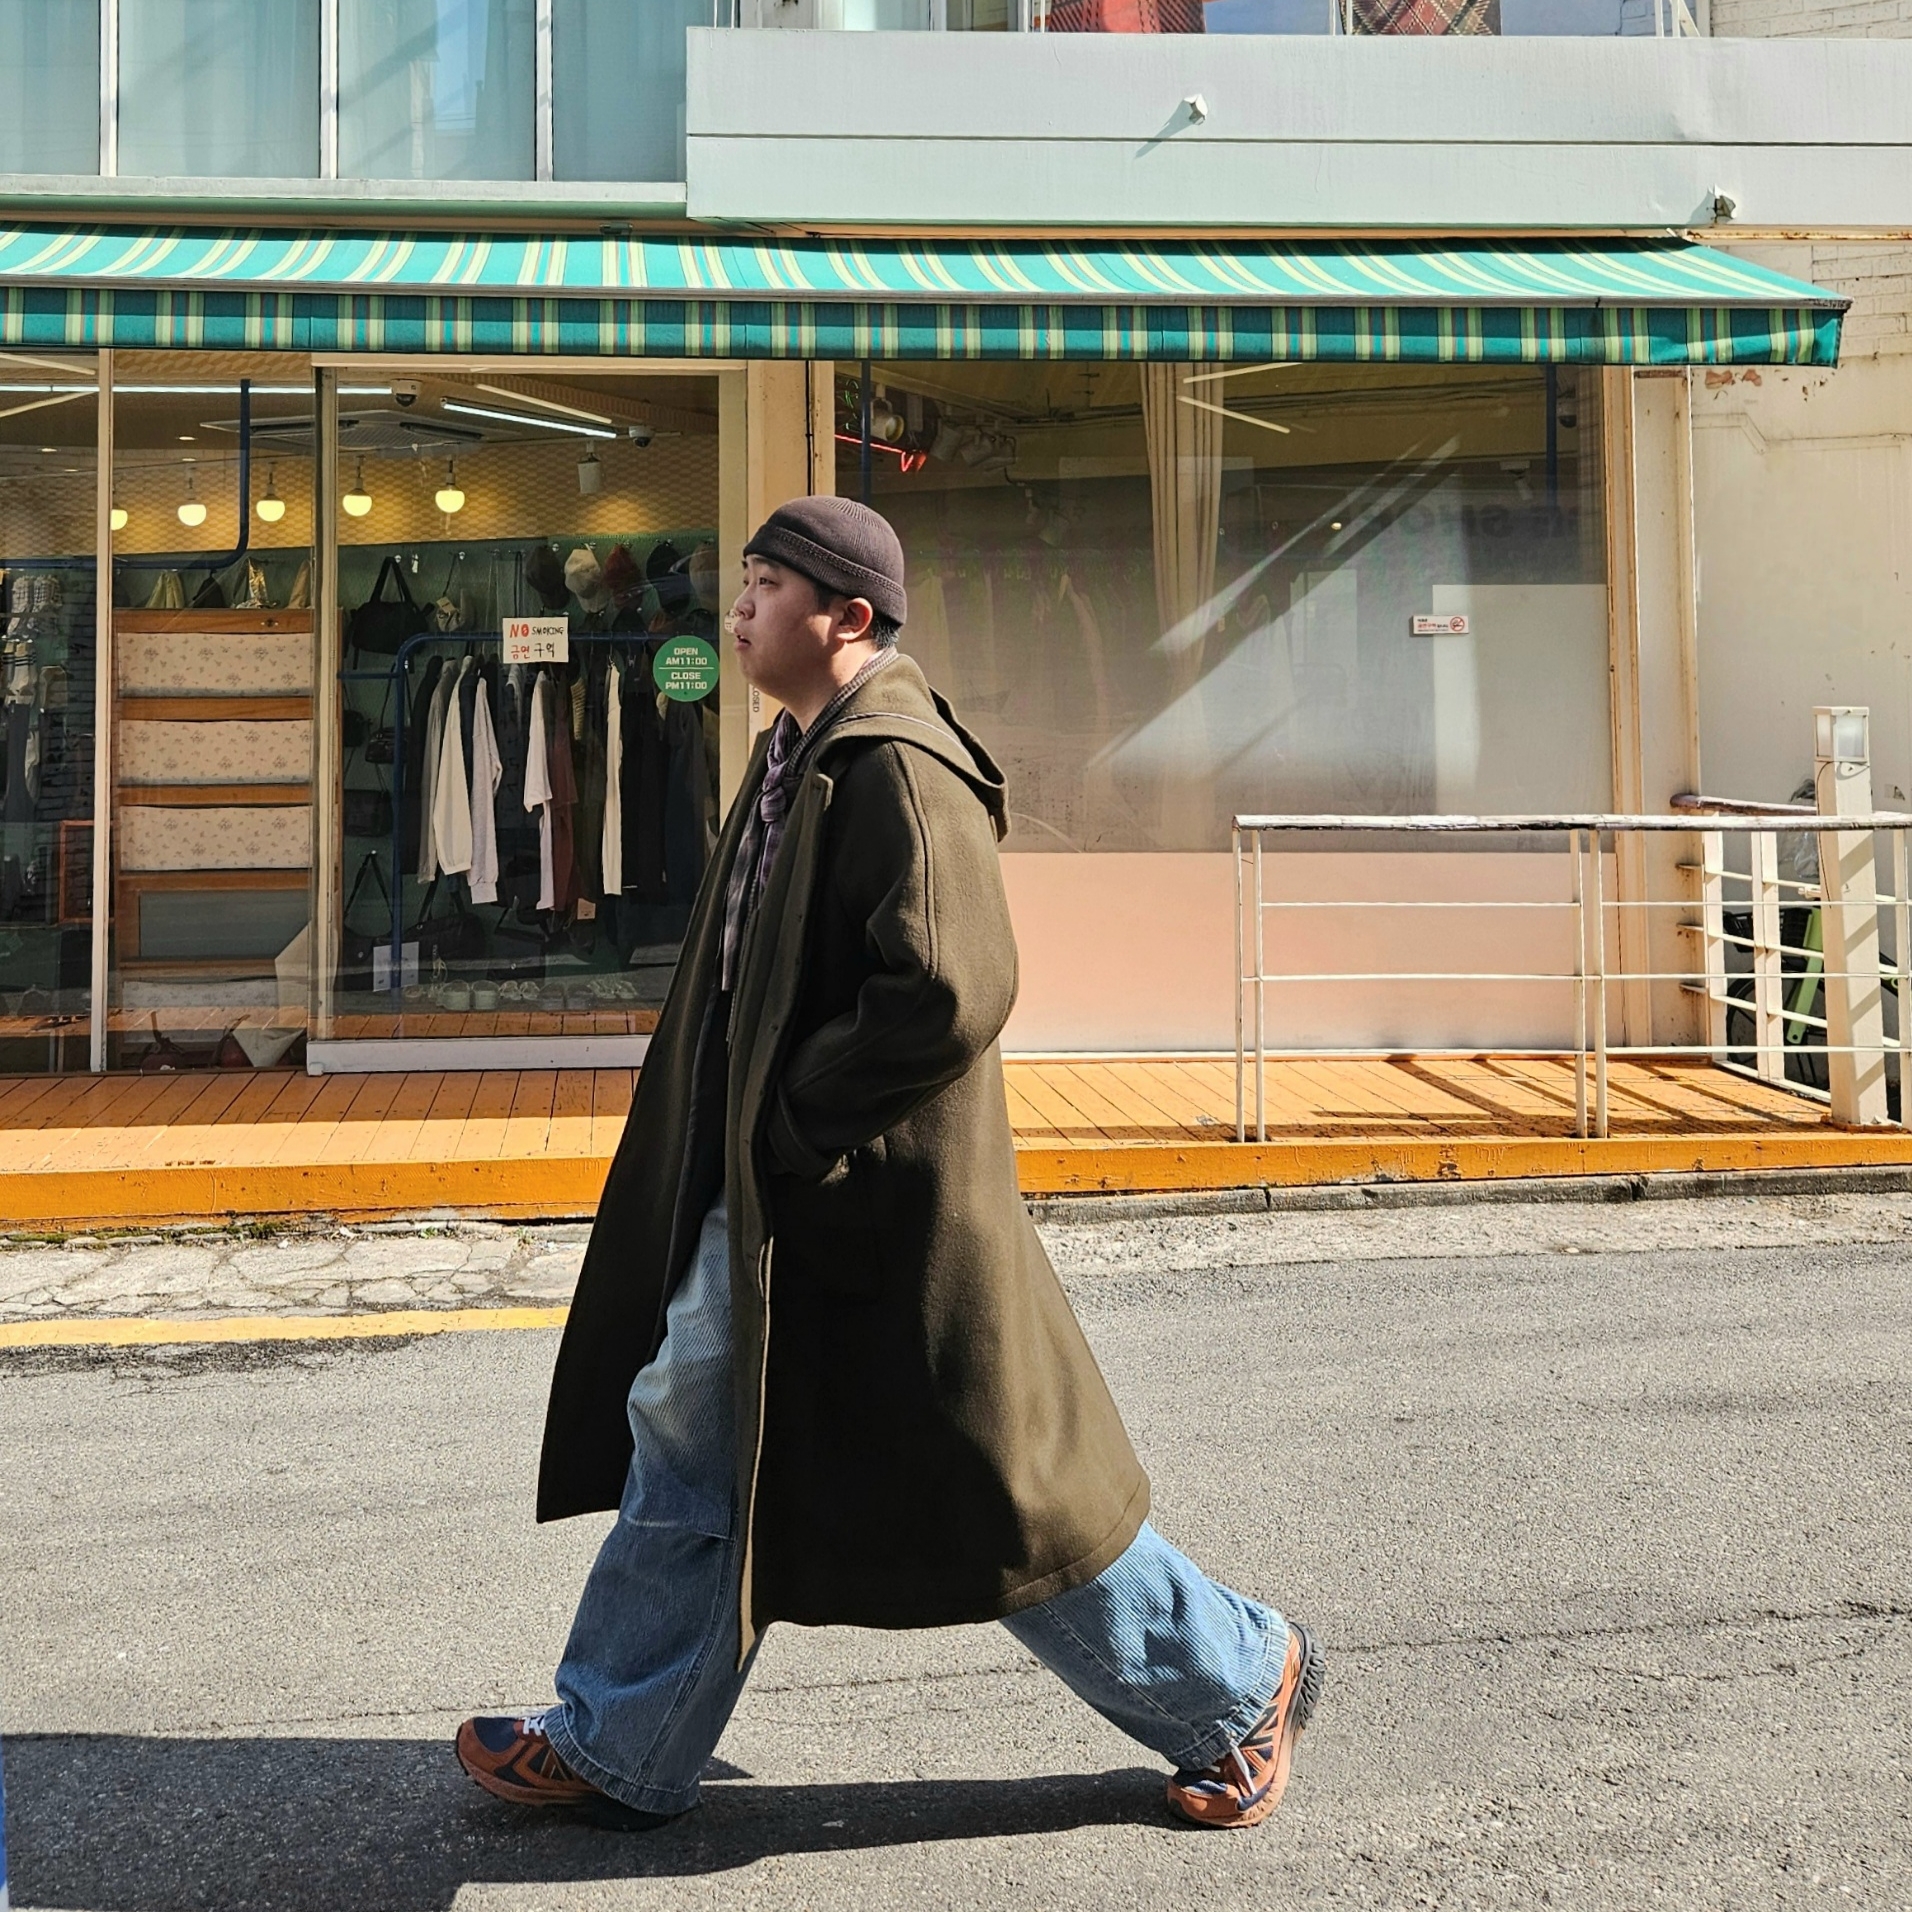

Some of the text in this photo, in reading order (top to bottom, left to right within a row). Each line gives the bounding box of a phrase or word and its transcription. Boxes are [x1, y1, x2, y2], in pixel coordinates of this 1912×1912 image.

[509, 624, 564, 638] NO SMOKING
[511, 642, 554, 660] 금연 구역
[673, 647, 698, 655] OPEN
[665, 657, 707, 665] AM11:00
[671, 672, 701, 680] CLOSE
[665, 681, 707, 689] PM11:00
